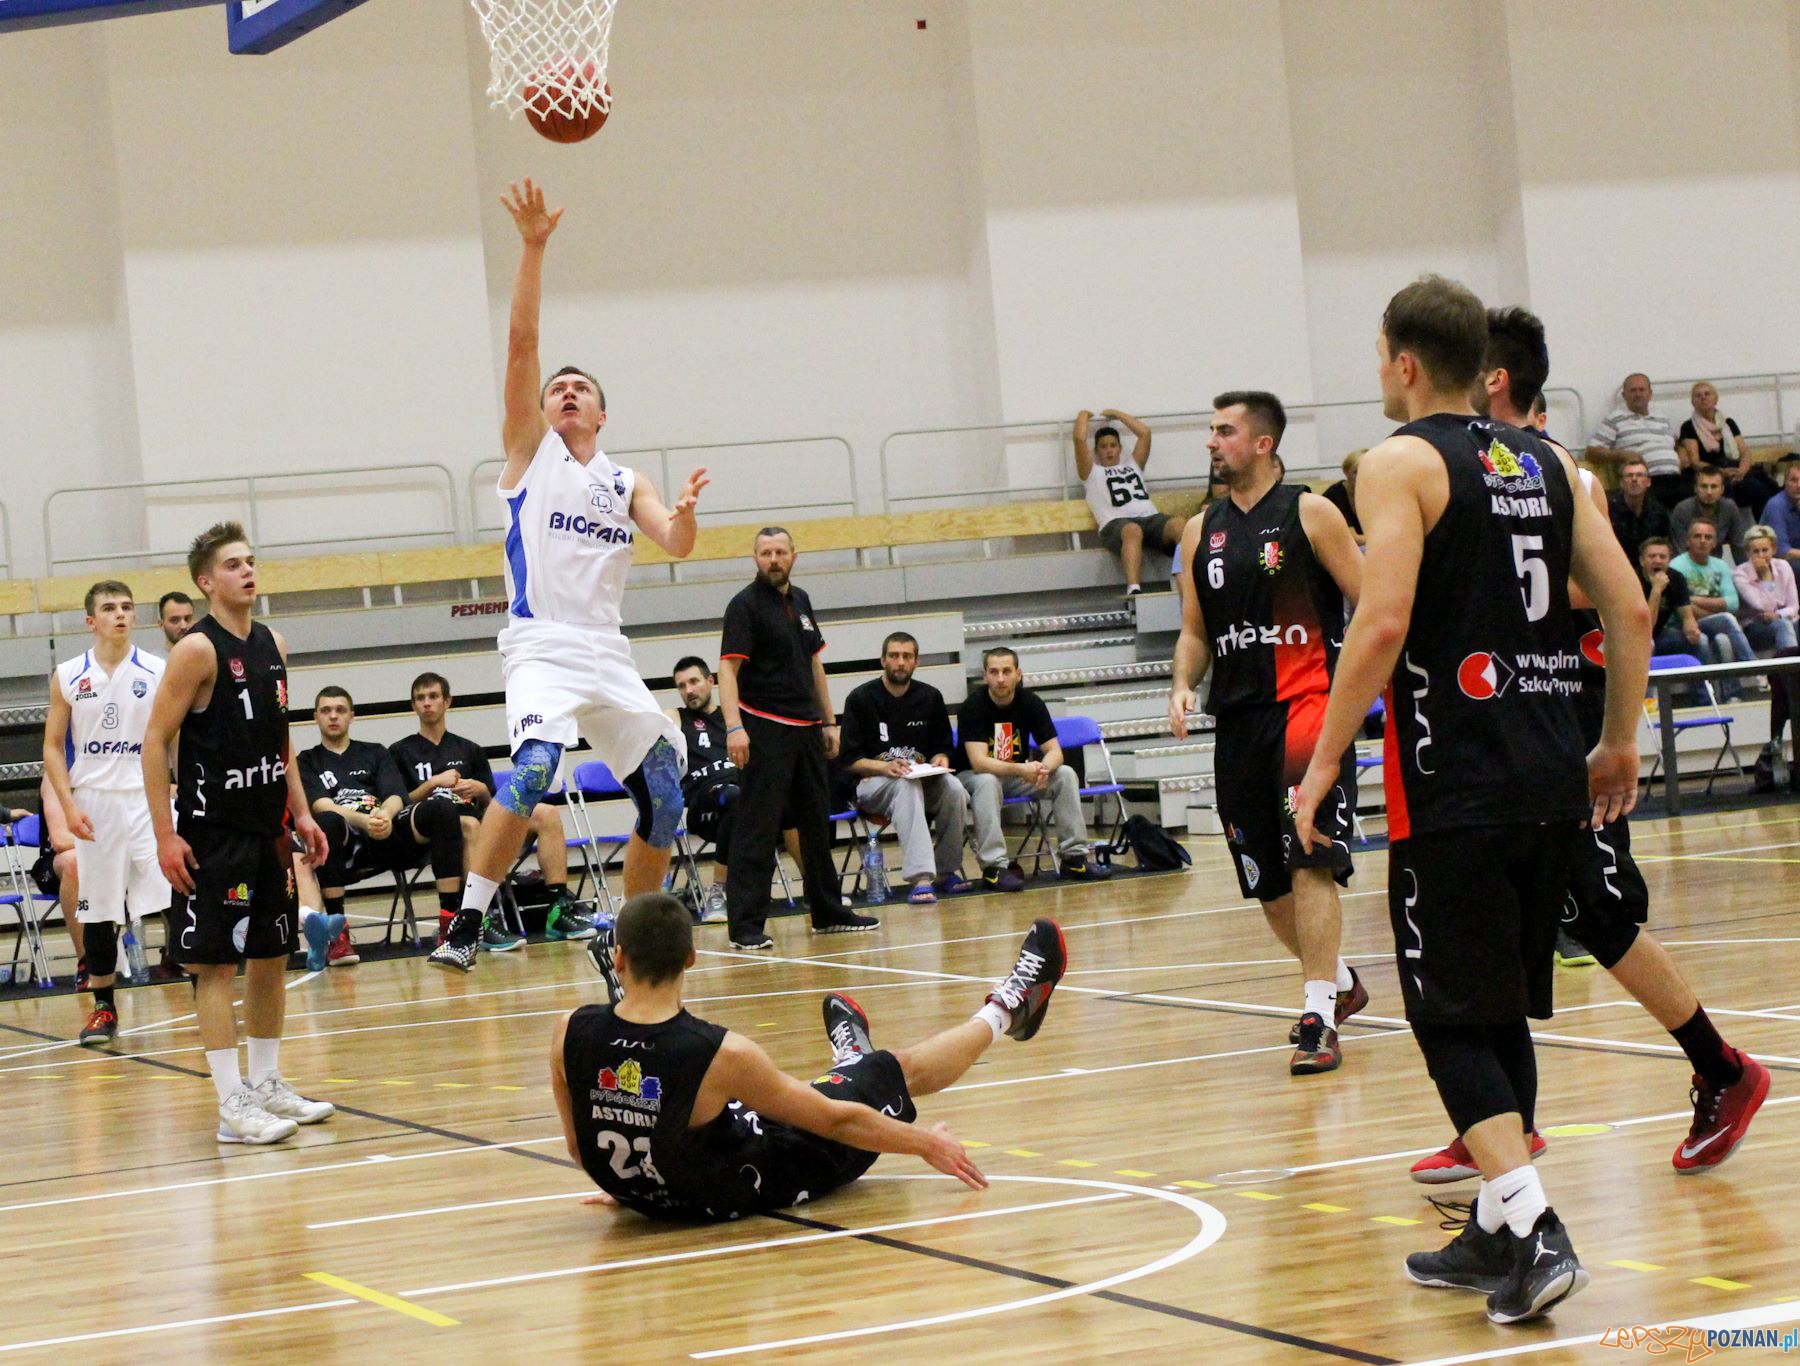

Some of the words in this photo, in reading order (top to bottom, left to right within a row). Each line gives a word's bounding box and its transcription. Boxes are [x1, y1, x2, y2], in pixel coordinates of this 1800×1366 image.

[1106, 472, 1150, 507] 63
[1207, 557, 1225, 590] 6
[1511, 534, 1550, 623] 5
[101, 702, 120, 730] 3
[238, 688, 254, 720] 1
[698, 732, 712, 748] 4
[879, 721, 890, 742] 9
[83, 740, 143, 755] IOFARM
[414, 762, 433, 781] 11
[275, 914, 289, 945] 1
